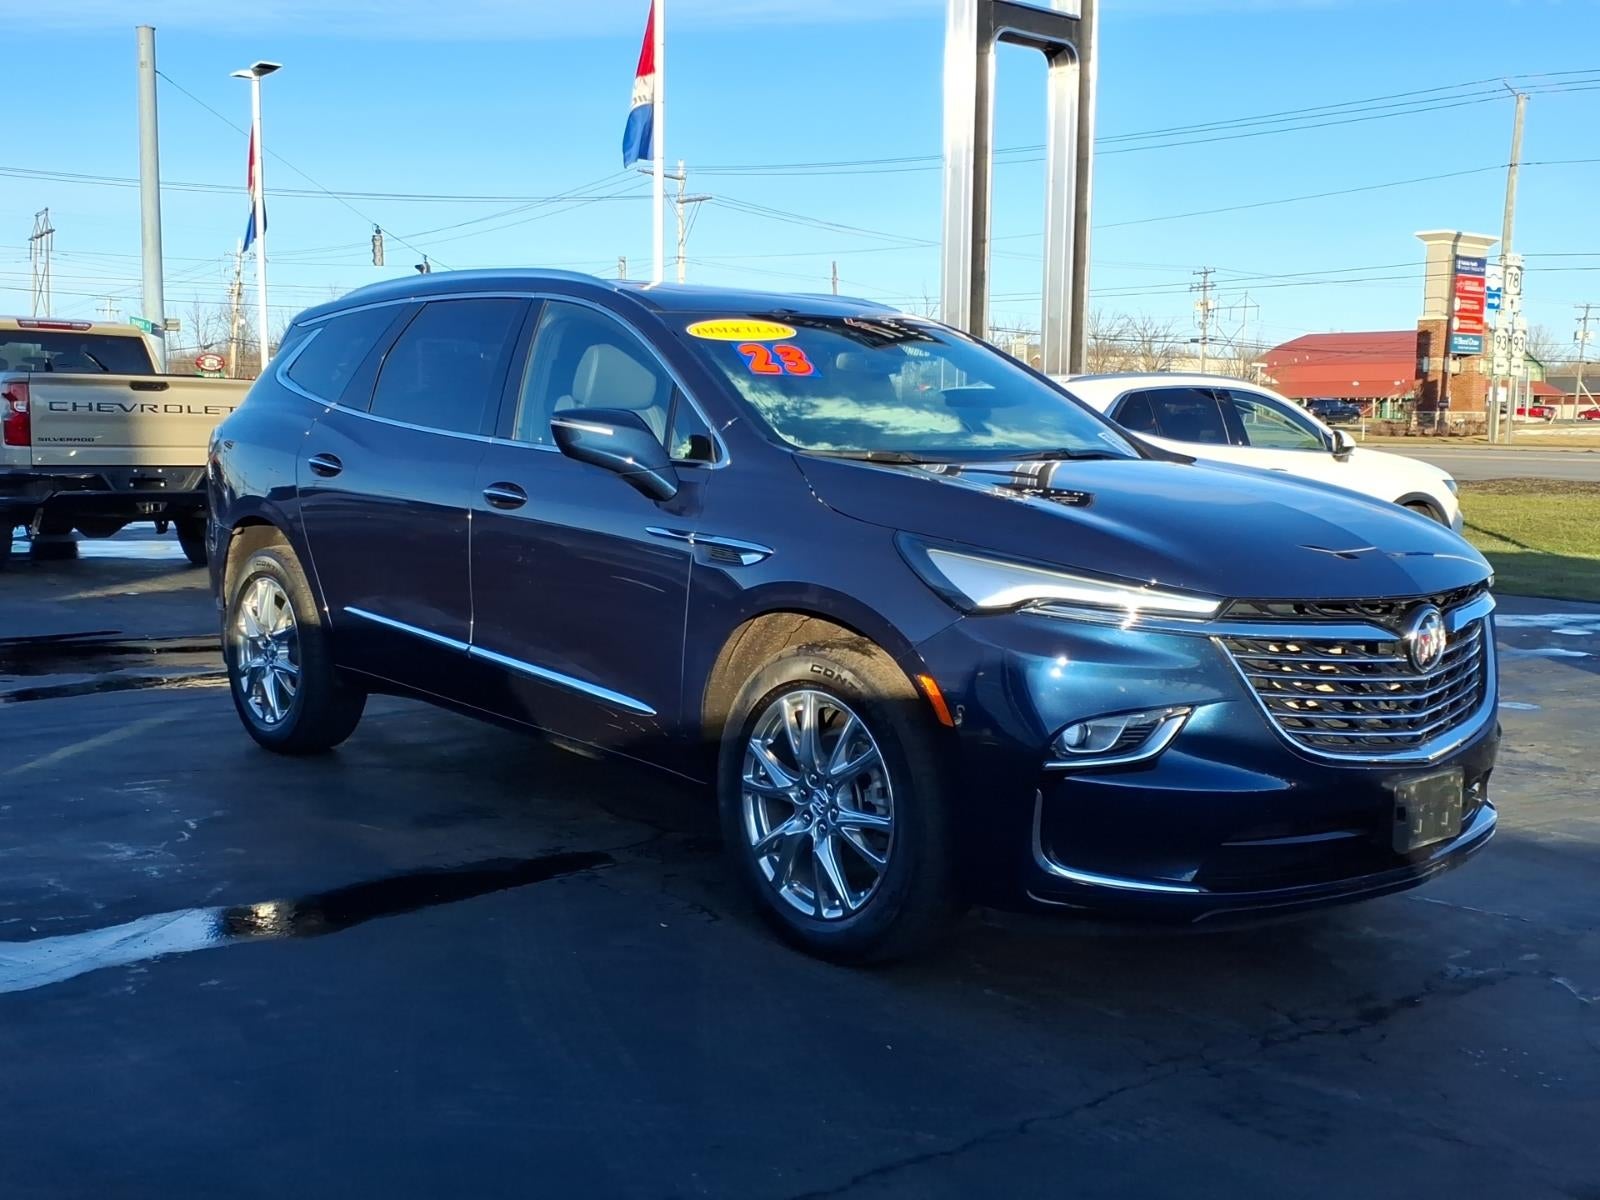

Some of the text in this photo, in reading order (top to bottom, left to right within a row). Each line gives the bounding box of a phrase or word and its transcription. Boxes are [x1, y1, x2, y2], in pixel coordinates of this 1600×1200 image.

[1508, 272, 1520, 288] 78
[1495, 334, 1507, 351] 93
[1513, 336, 1525, 353] 93
[737, 343, 814, 376] 23
